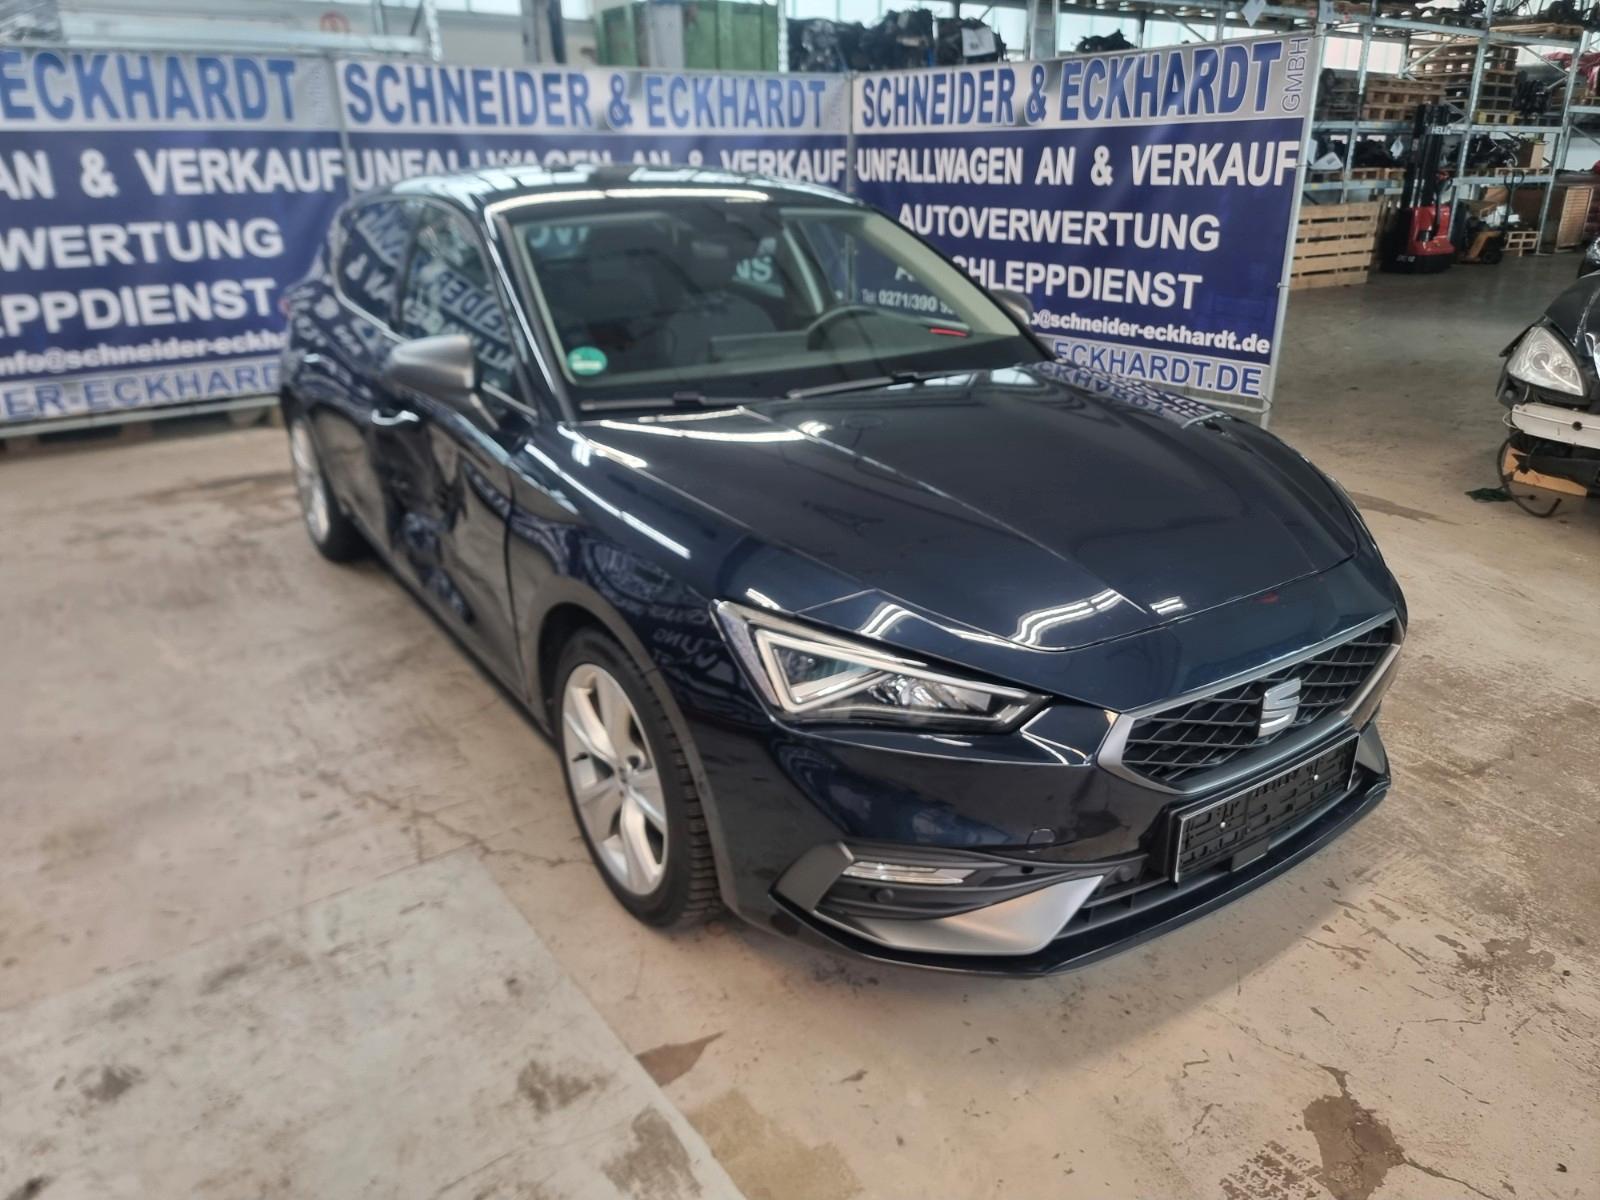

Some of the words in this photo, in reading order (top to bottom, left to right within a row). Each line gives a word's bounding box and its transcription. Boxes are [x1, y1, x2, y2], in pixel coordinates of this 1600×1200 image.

[0, 51, 295, 120] ECKHARDT
[344, 63, 592, 127] SCHNEIDER
[606, 74, 633, 128] &
[647, 75, 826, 128] ECKHARDT
[862, 69, 1015, 127] SCHNEIDER
[1024, 64, 1047, 124] &
[1060, 41, 1283, 121] ECKHARDT
[1281, 37, 1309, 112] GMBH
[80, 148, 119, 199] &
[134, 148, 344, 196] VERKAUF
[857, 147, 1023, 185] UNFALLWAGEN
[1035, 147, 1076, 185] AN
[1091, 146, 1114, 186] &
[1131, 140, 1299, 187] VERKAUF
[898, 202, 1221, 252] AUTOVERWERTUNG
[0, 277, 276, 338] PPDIENST
